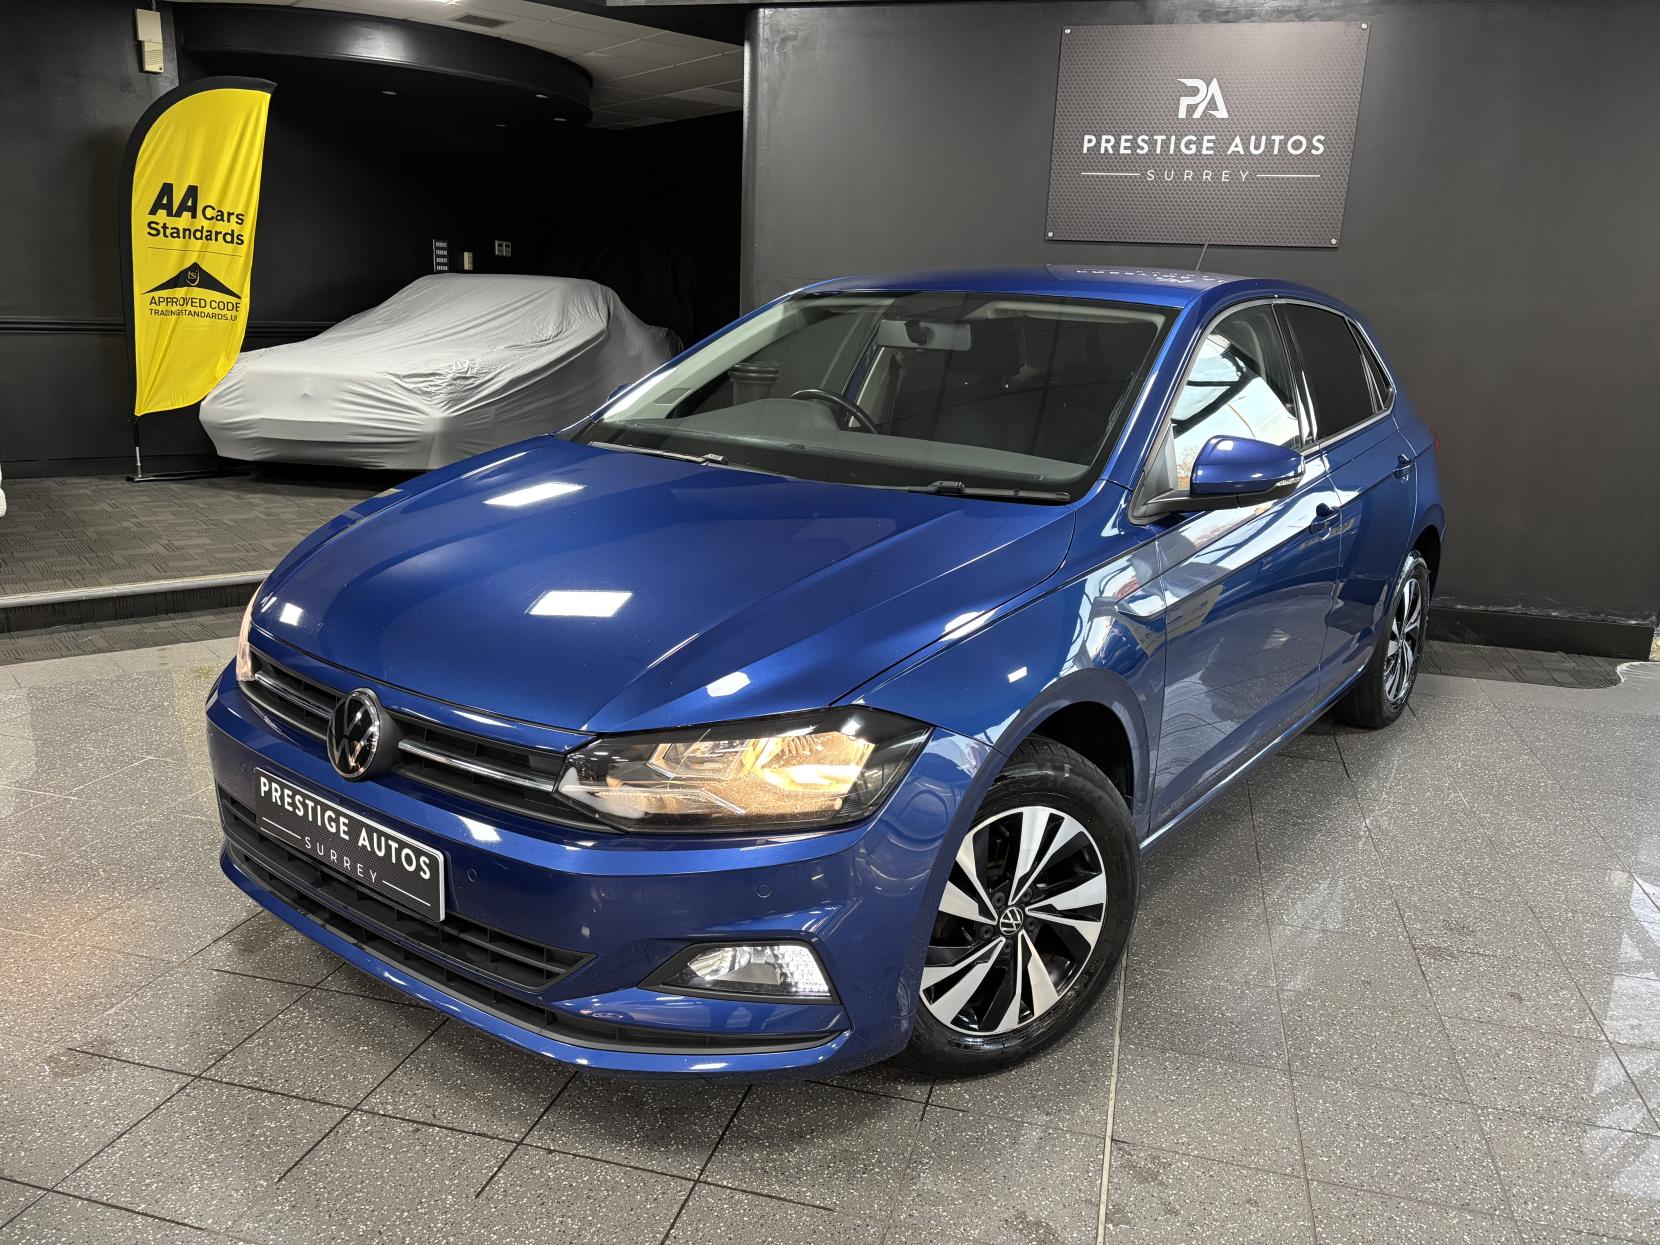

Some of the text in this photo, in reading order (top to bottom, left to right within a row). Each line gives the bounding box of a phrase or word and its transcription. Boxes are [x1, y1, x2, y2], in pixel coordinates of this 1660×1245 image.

[1176, 77, 1229, 118] PA
[1082, 134, 1326, 155] PRESTIGE AUTOS
[1146, 169, 1250, 182] SURREY
[148, 182, 245, 226] AA Cars
[146, 220, 245, 246] Standards
[149, 295, 240, 313] APPROVED CODE
[260, 776, 431, 880] PRESTIGE AUTOS
[304, 836, 377, 883] SURREY
